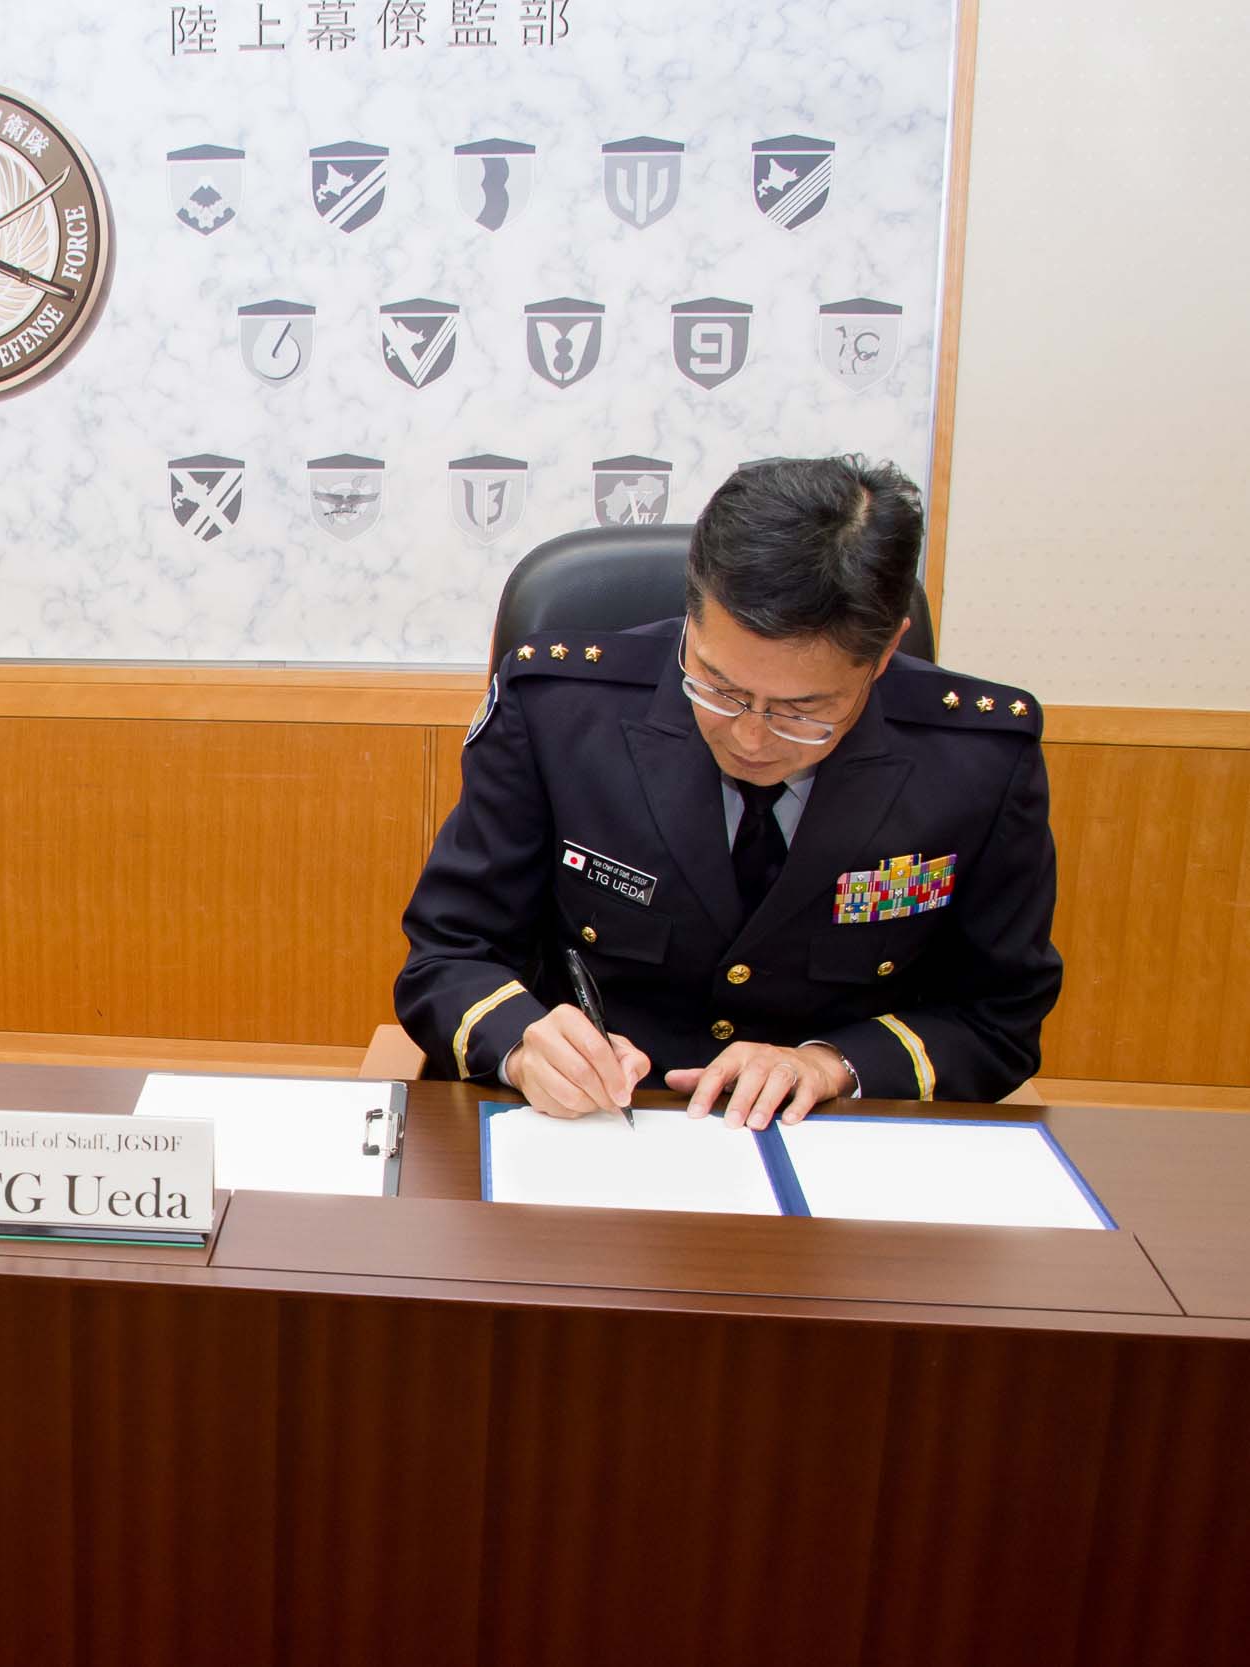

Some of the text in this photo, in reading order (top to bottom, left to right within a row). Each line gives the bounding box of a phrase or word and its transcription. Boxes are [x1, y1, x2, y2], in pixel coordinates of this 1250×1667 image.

[170, 0, 570, 57] 陸上幕僚監部
[61, 205, 88, 283] FORCE
[689, 322, 734, 375] 9
[587, 868, 645, 901] LTG UEDA
[42, 1131, 62, 1150] of
[65, 1132, 110, 1152] Staff,
[113, 1134, 183, 1153] JGSDF
[63, 1174, 192, 1219] Ueda
